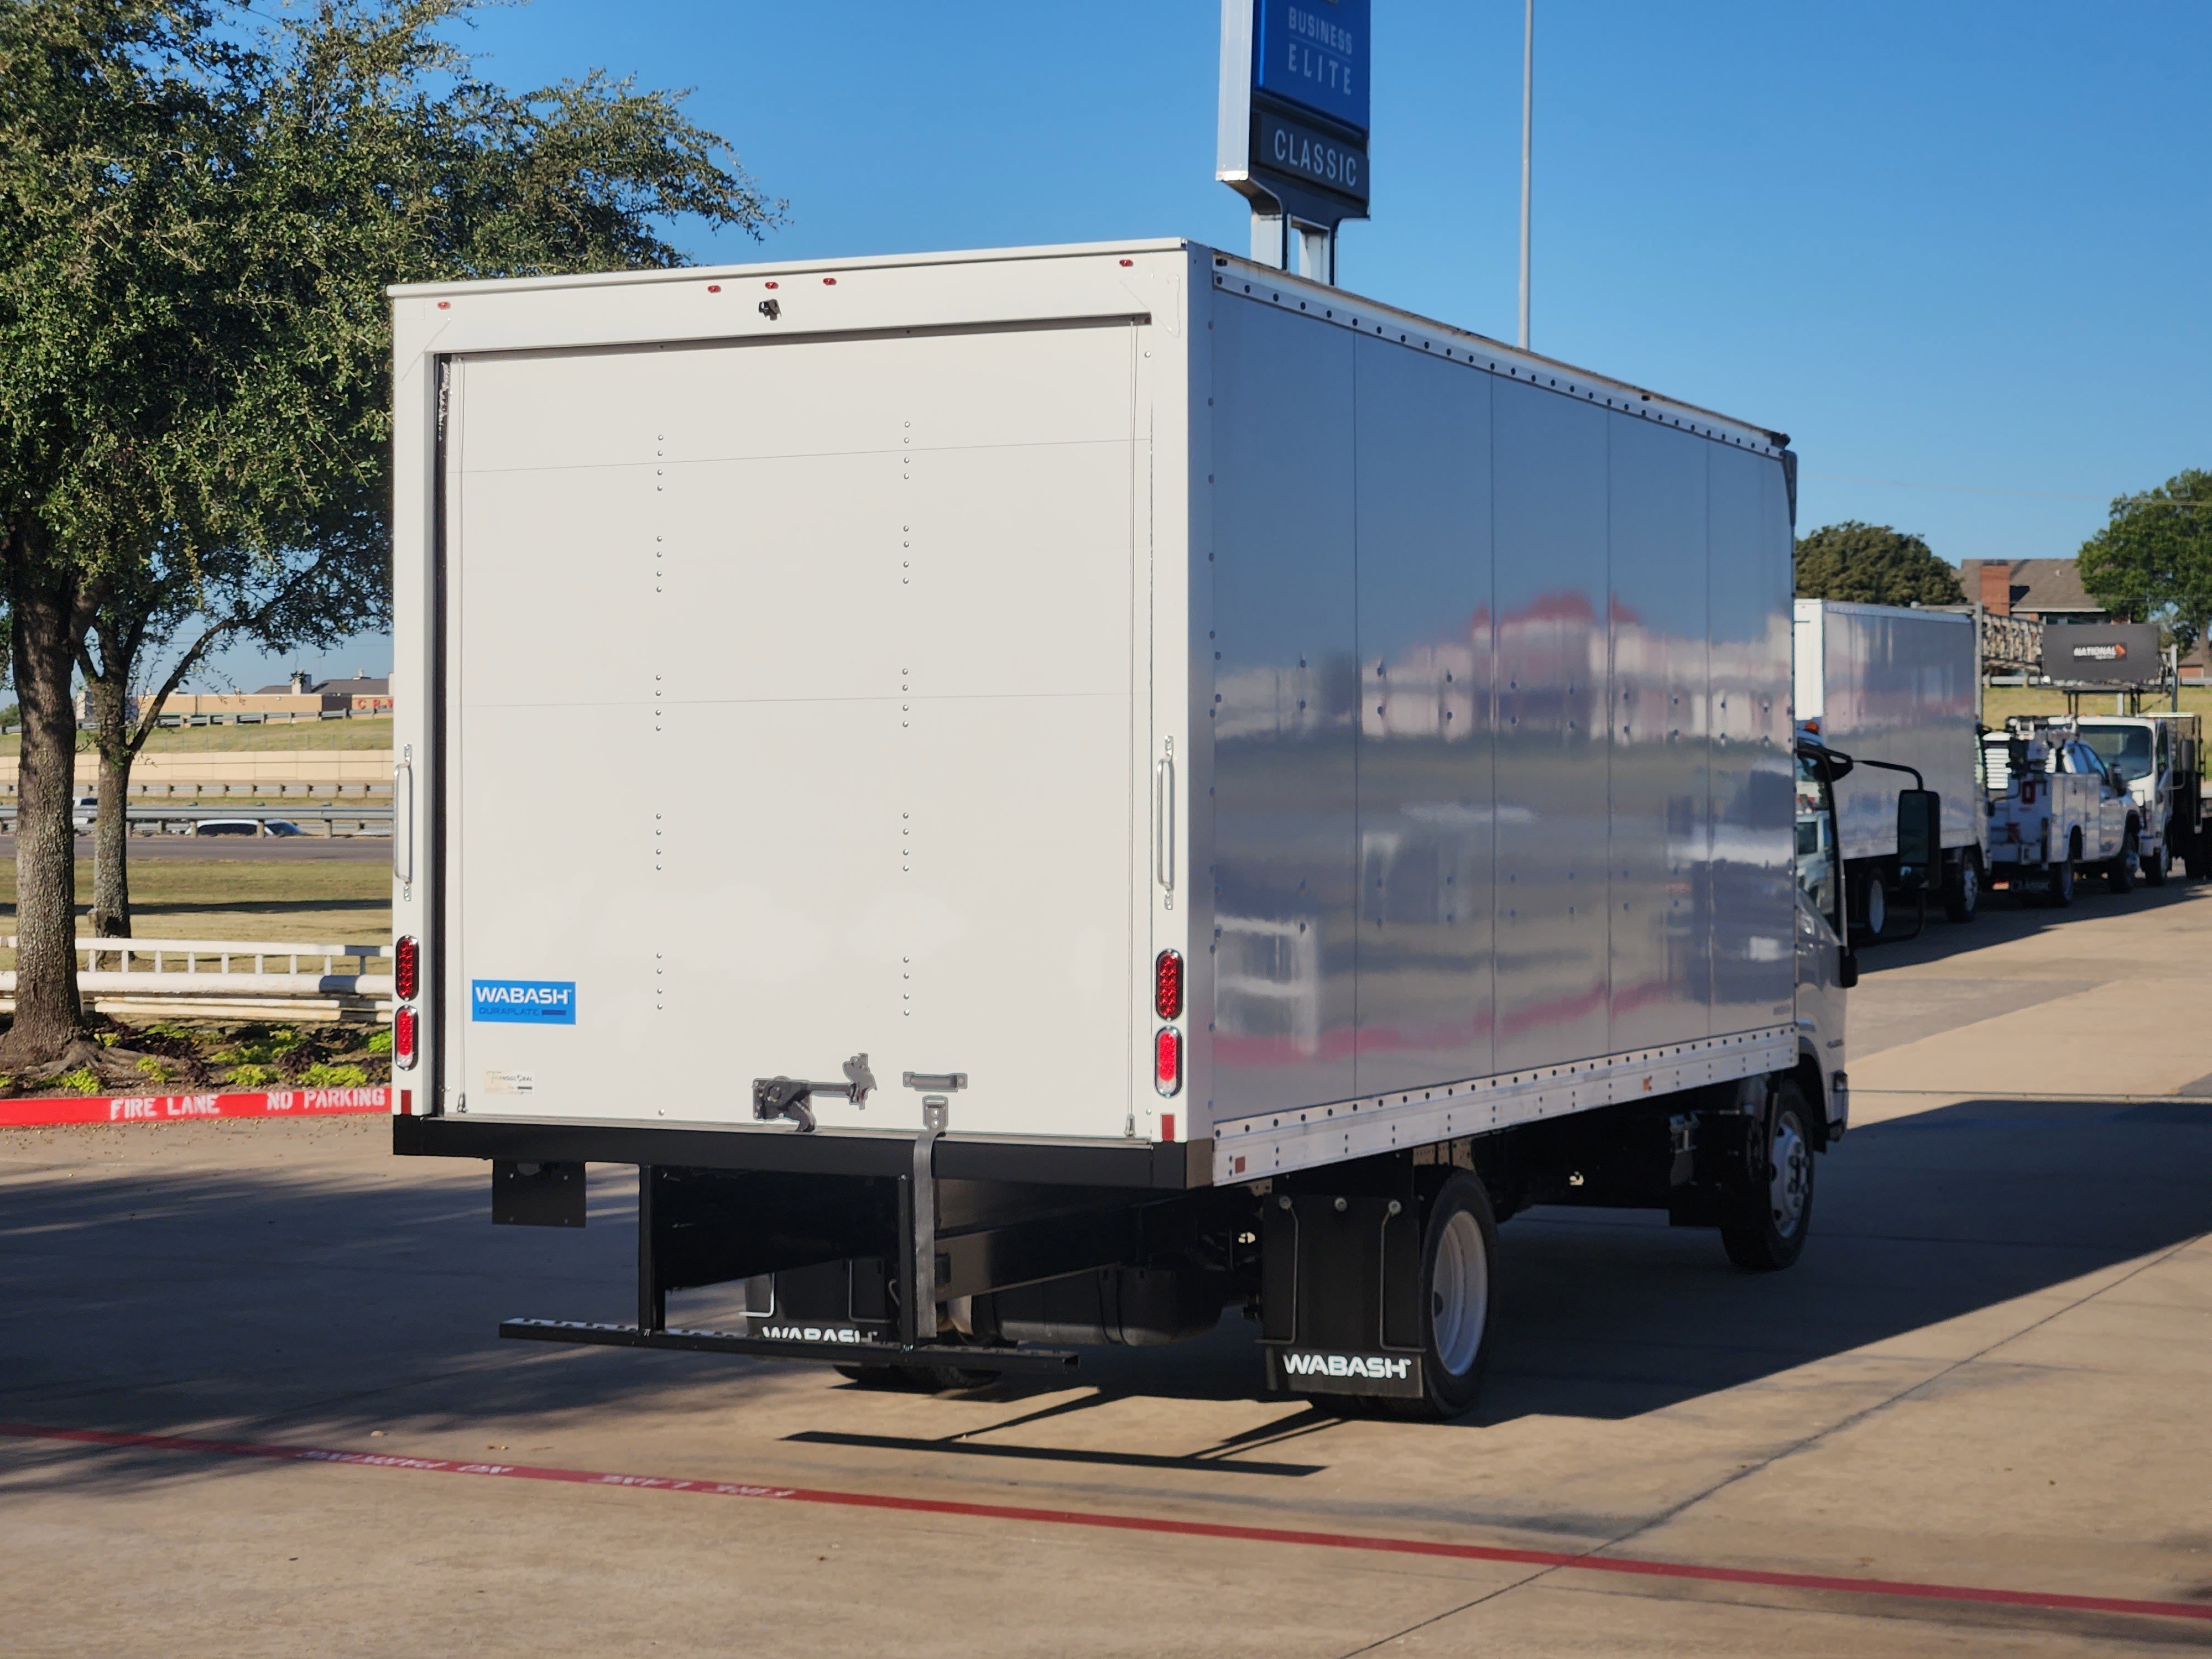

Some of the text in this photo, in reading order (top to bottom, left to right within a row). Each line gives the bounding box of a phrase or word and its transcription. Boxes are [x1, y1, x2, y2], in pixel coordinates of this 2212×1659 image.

[1288, 6, 1353, 55] BUSINESS
[1288, 44, 1352, 96] ELITE
[1275, 129, 1357, 187] CLASSIC
[475, 987, 568, 1005] WABASH
[111, 1088, 385, 1121] FIRE LANE NO PARKING
[1283, 1354, 1412, 1379] WABASH
